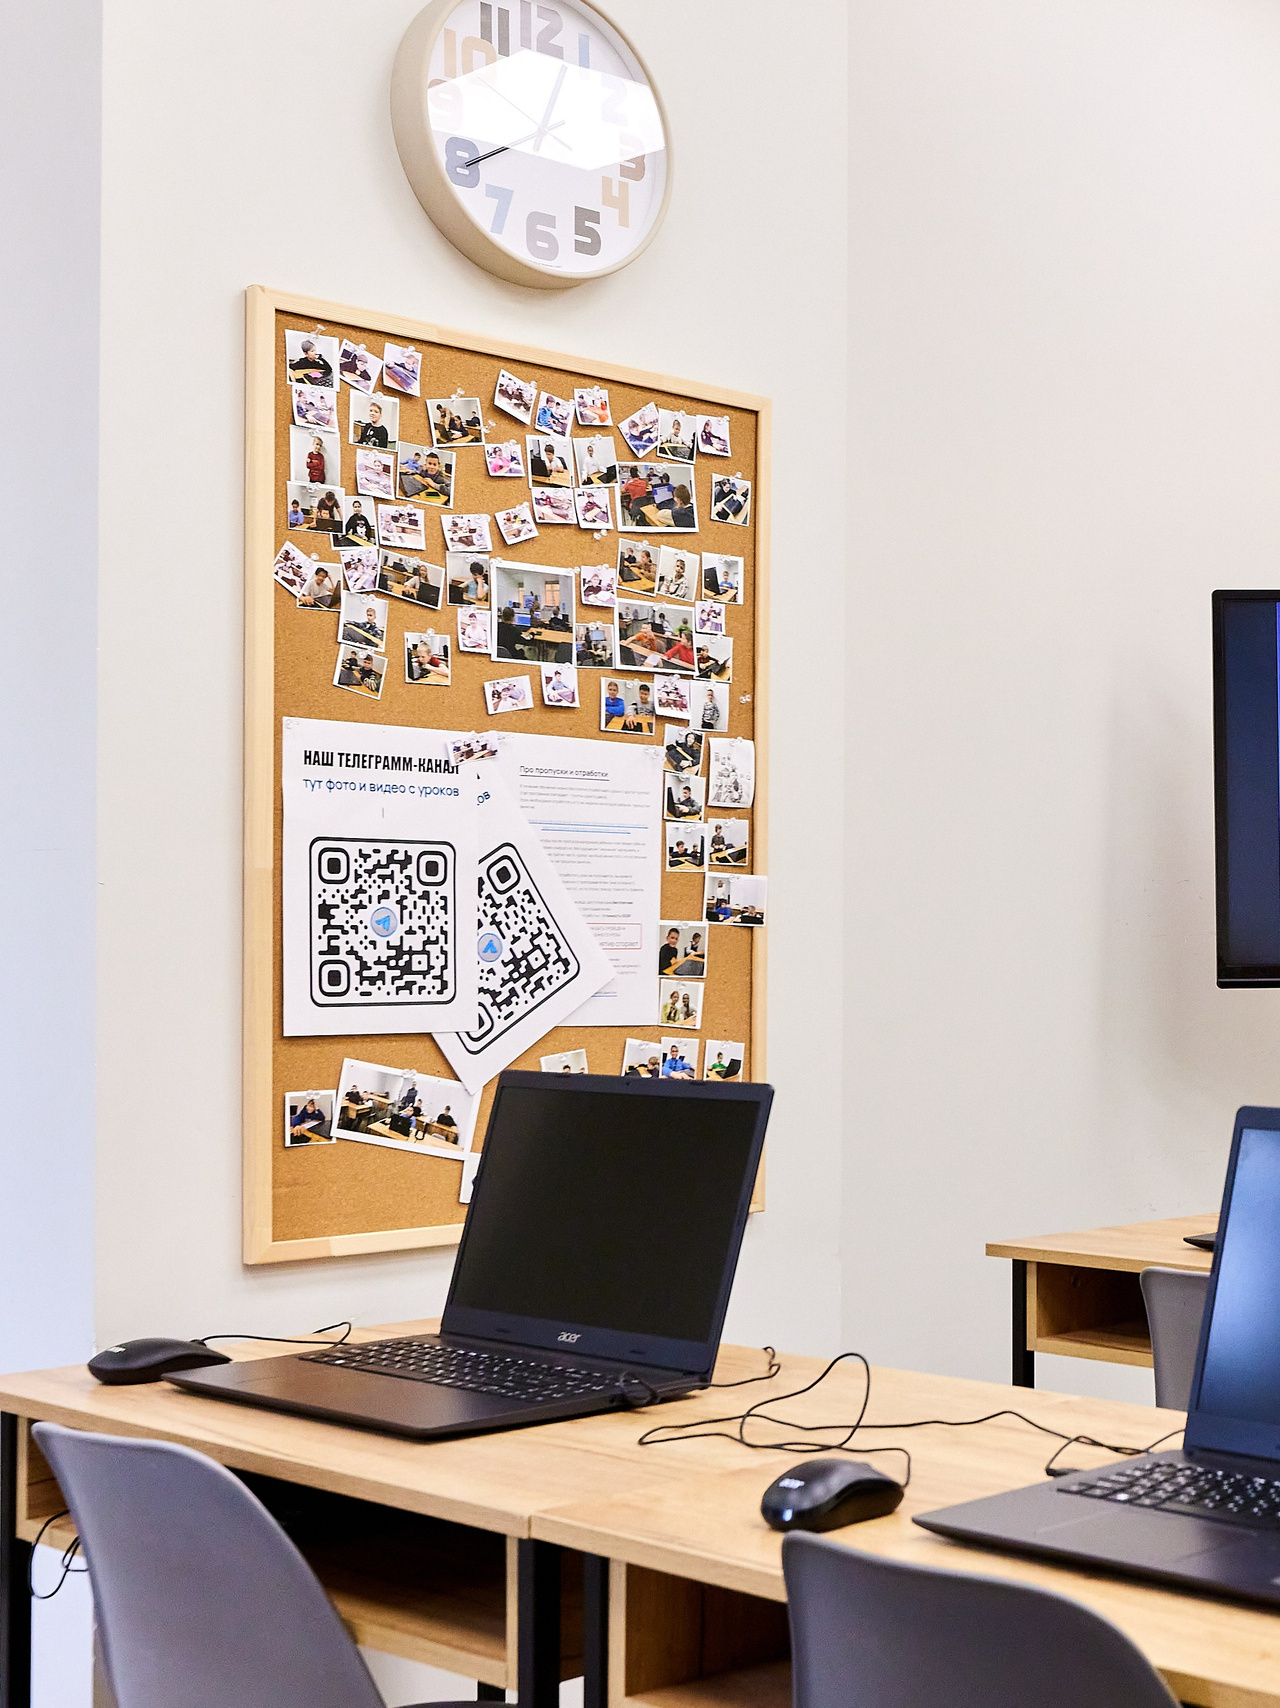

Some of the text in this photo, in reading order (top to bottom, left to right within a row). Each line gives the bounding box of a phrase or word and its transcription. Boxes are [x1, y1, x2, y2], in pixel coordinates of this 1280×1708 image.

[480, 1, 510, 58] 11
[519, 0, 564, 60] 12
[444, 27, 497, 88] 10
[445, 136, 481, 189] 8
[485, 184, 514, 235] 7
[601, 176, 630, 228] 4
[526, 211, 559, 262] 6
[574, 205, 602, 257] 5
[303, 749, 334, 767] НАШ
[519, 766, 534, 776] Про
[535, 767, 568, 777] пропуски
[575, 769, 608, 778] отработки
[302, 778, 460, 798] тут фото и видео с уроков
[557, 1331, 582, 1343] acer
